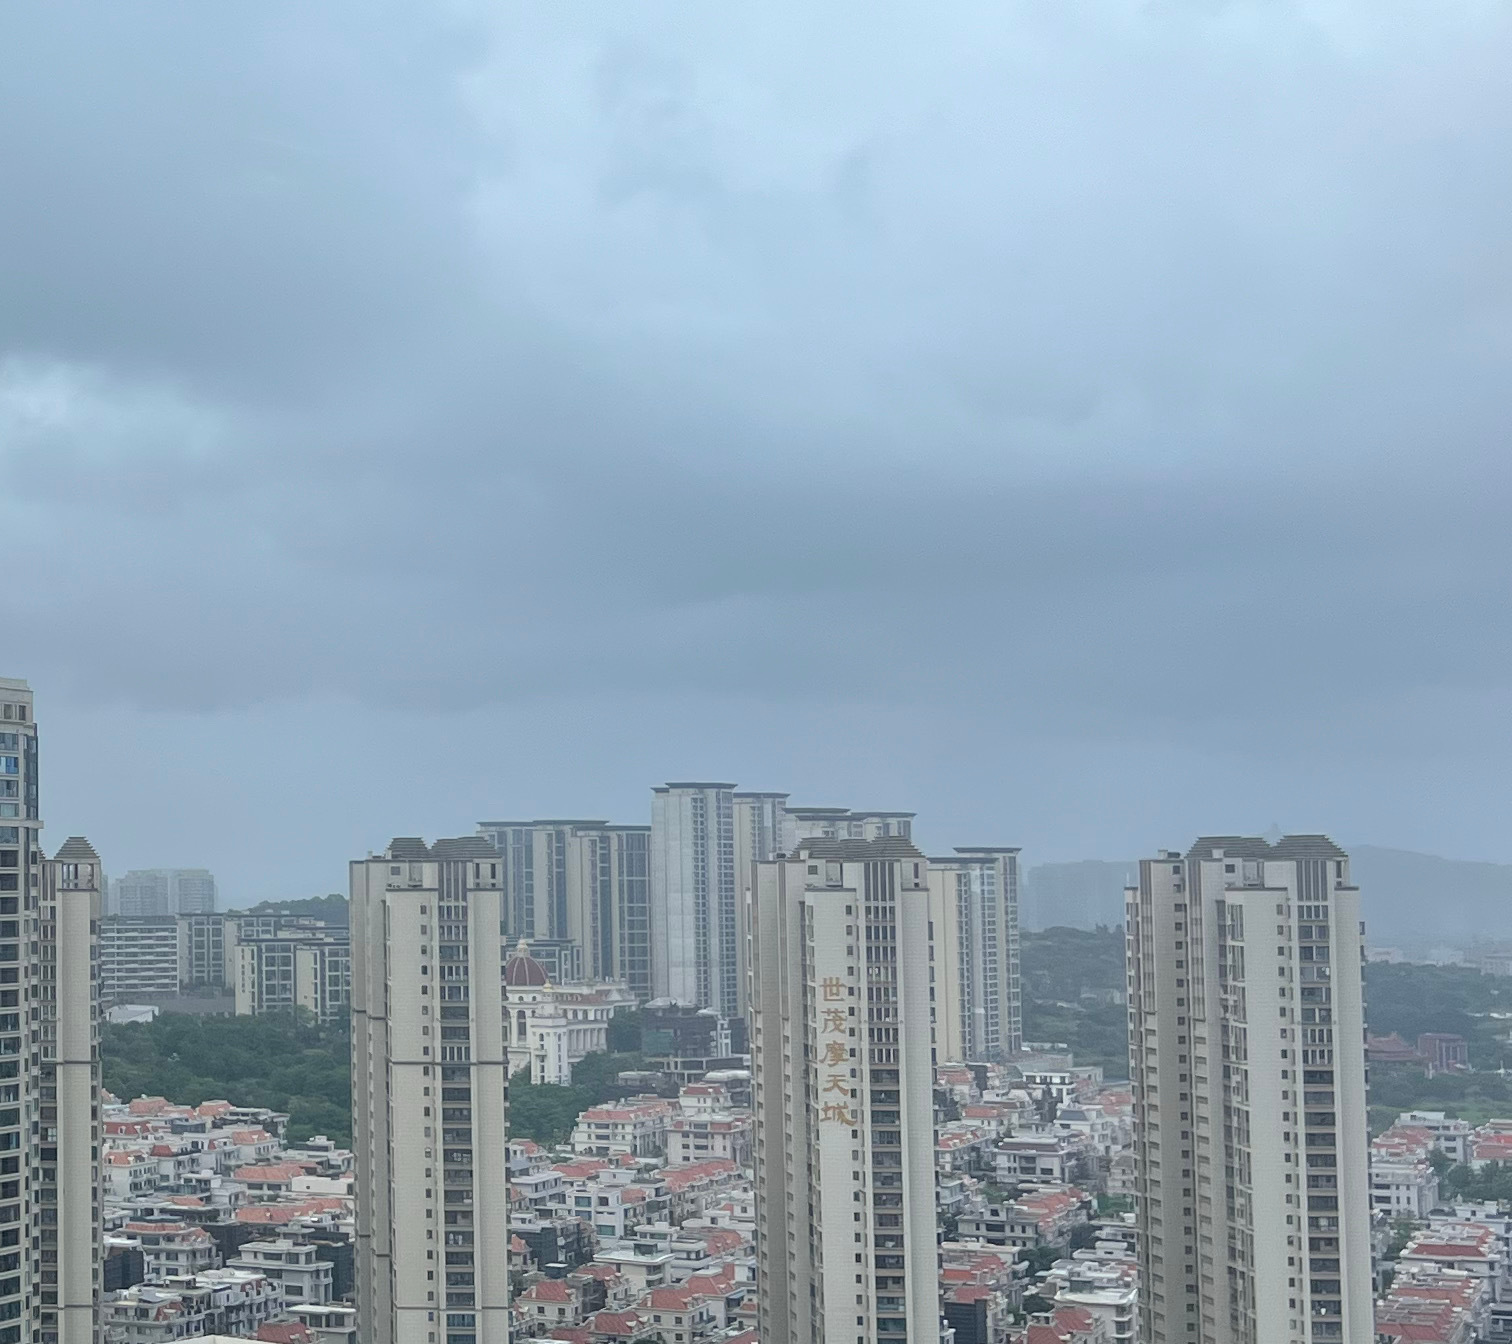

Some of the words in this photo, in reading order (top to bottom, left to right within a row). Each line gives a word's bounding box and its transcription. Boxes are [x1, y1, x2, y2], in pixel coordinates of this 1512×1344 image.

[819, 976, 857, 1126] 世茂摩天城
